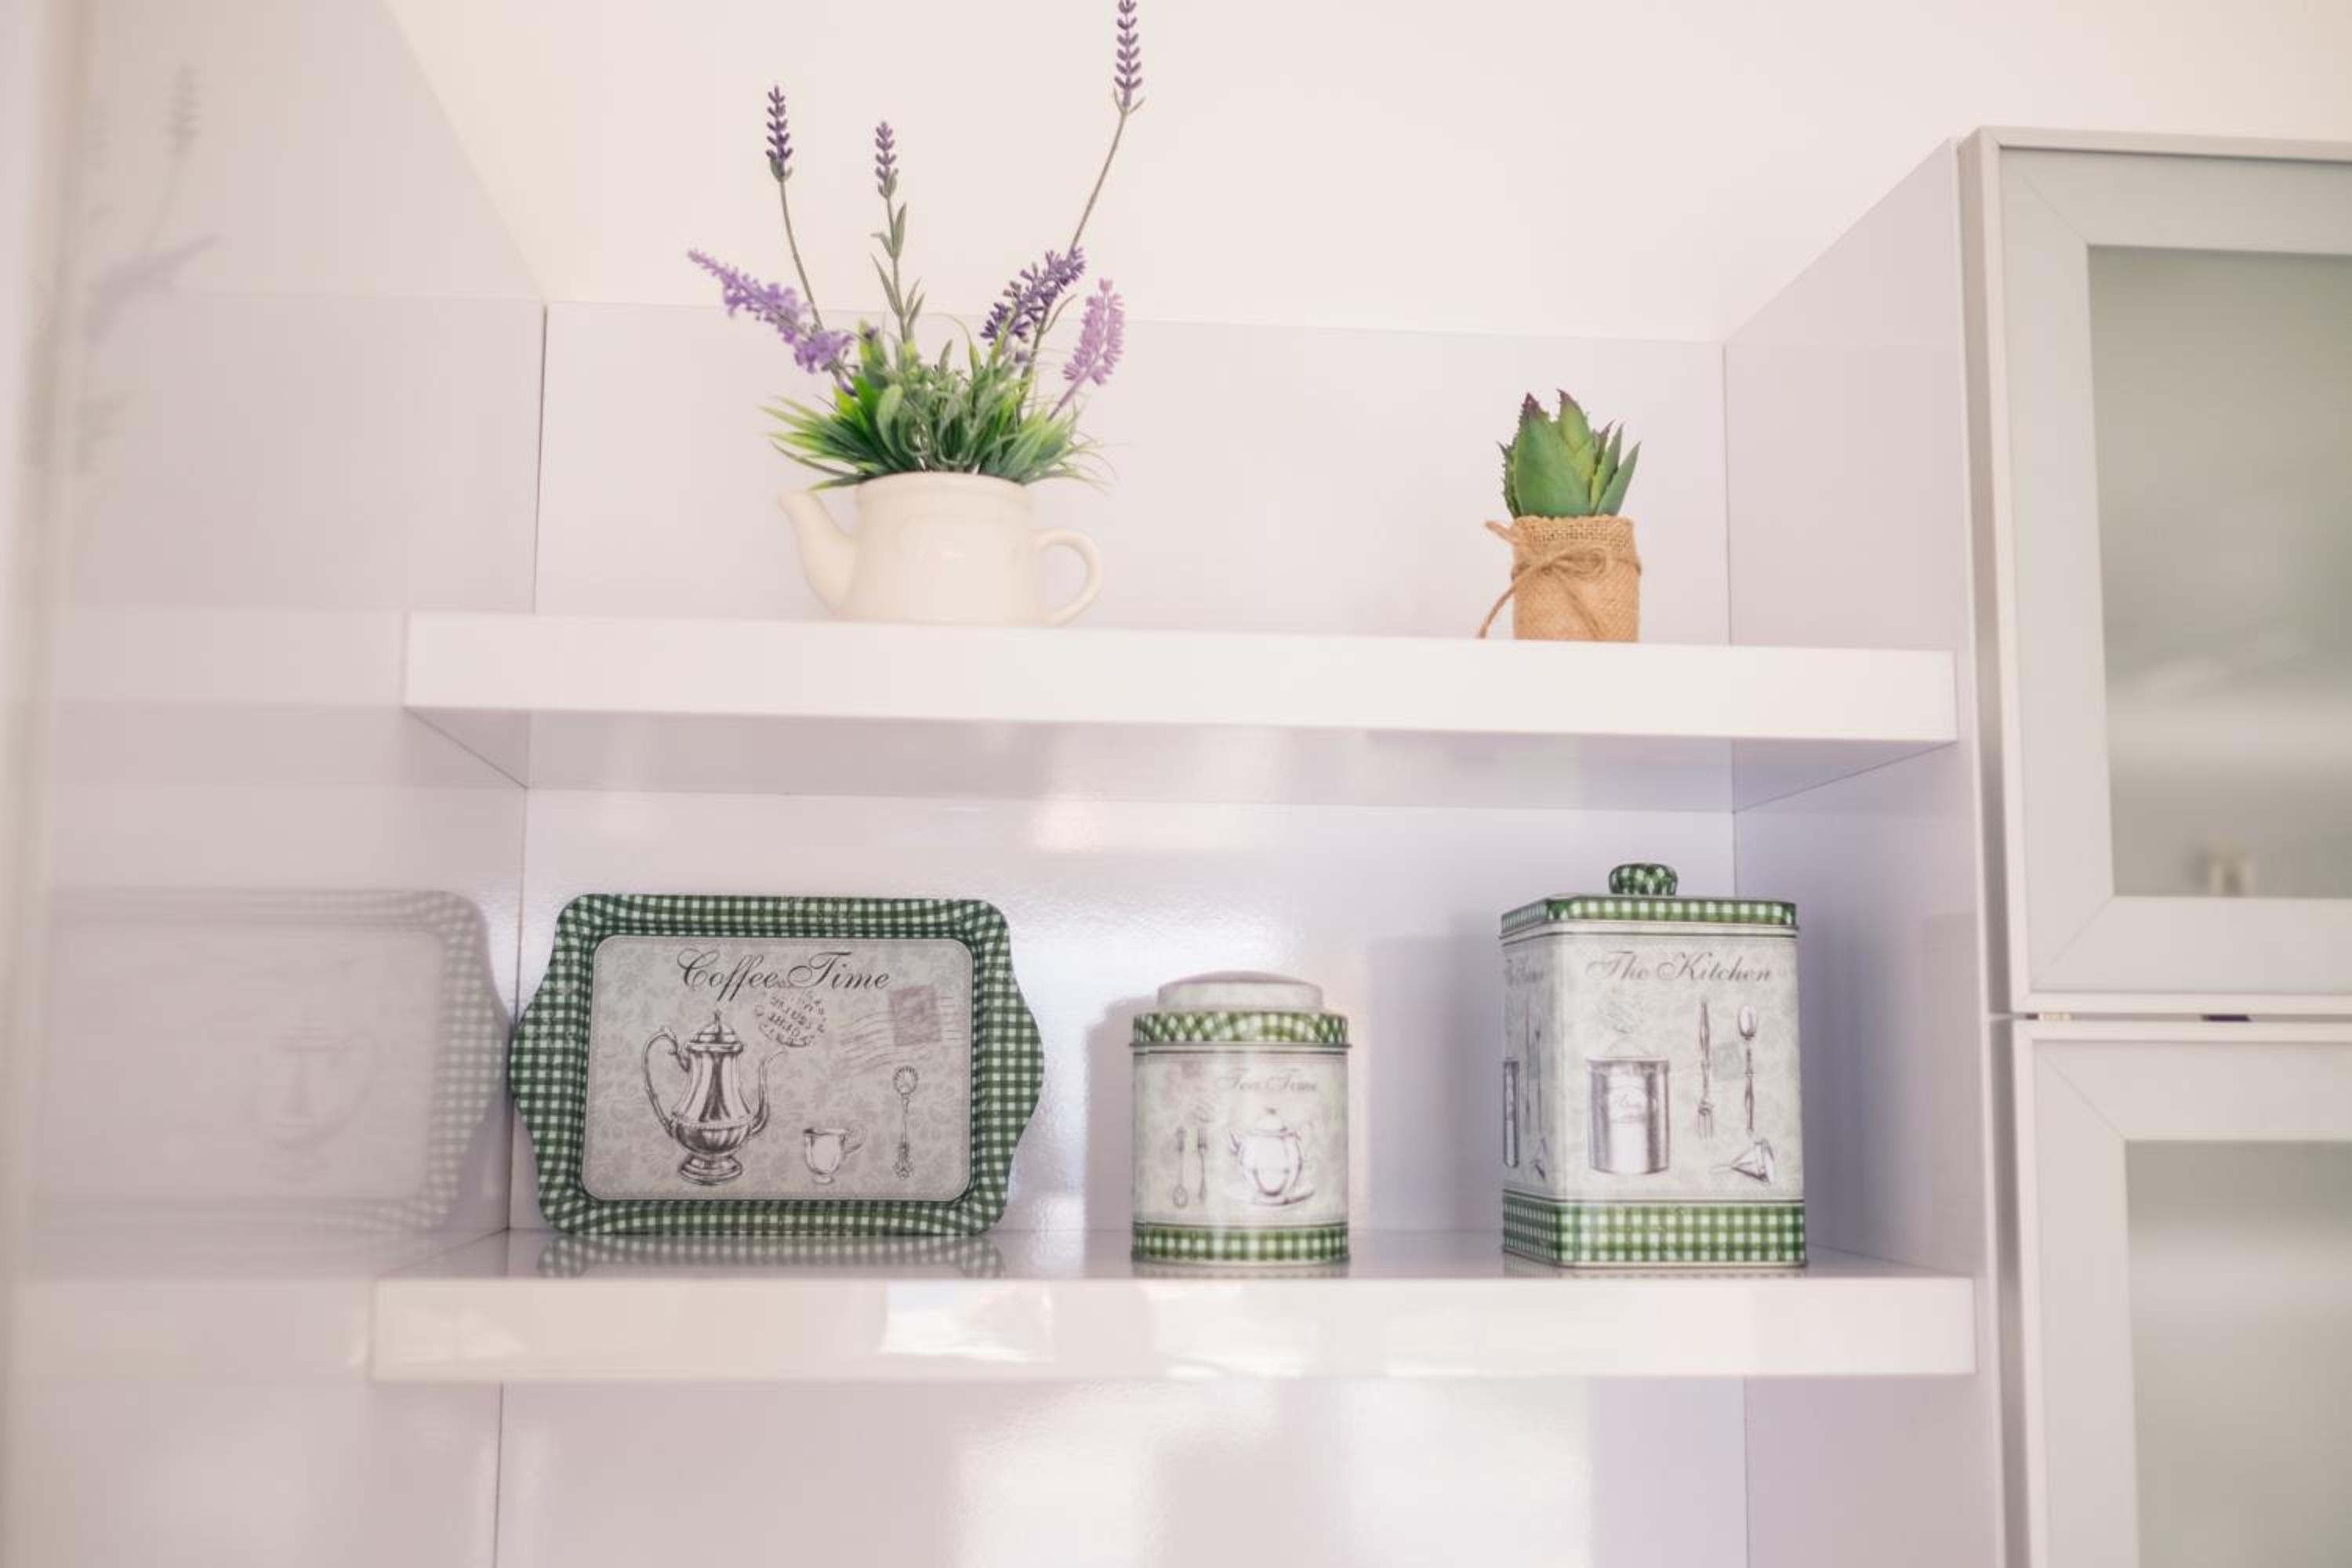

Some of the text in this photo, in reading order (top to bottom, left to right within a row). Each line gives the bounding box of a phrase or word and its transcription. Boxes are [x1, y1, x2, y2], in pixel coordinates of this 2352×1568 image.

[677, 948, 890, 1002] Coffee Time
[1584, 950, 1650, 980] The
[1656, 950, 1772, 982] Kitchen
